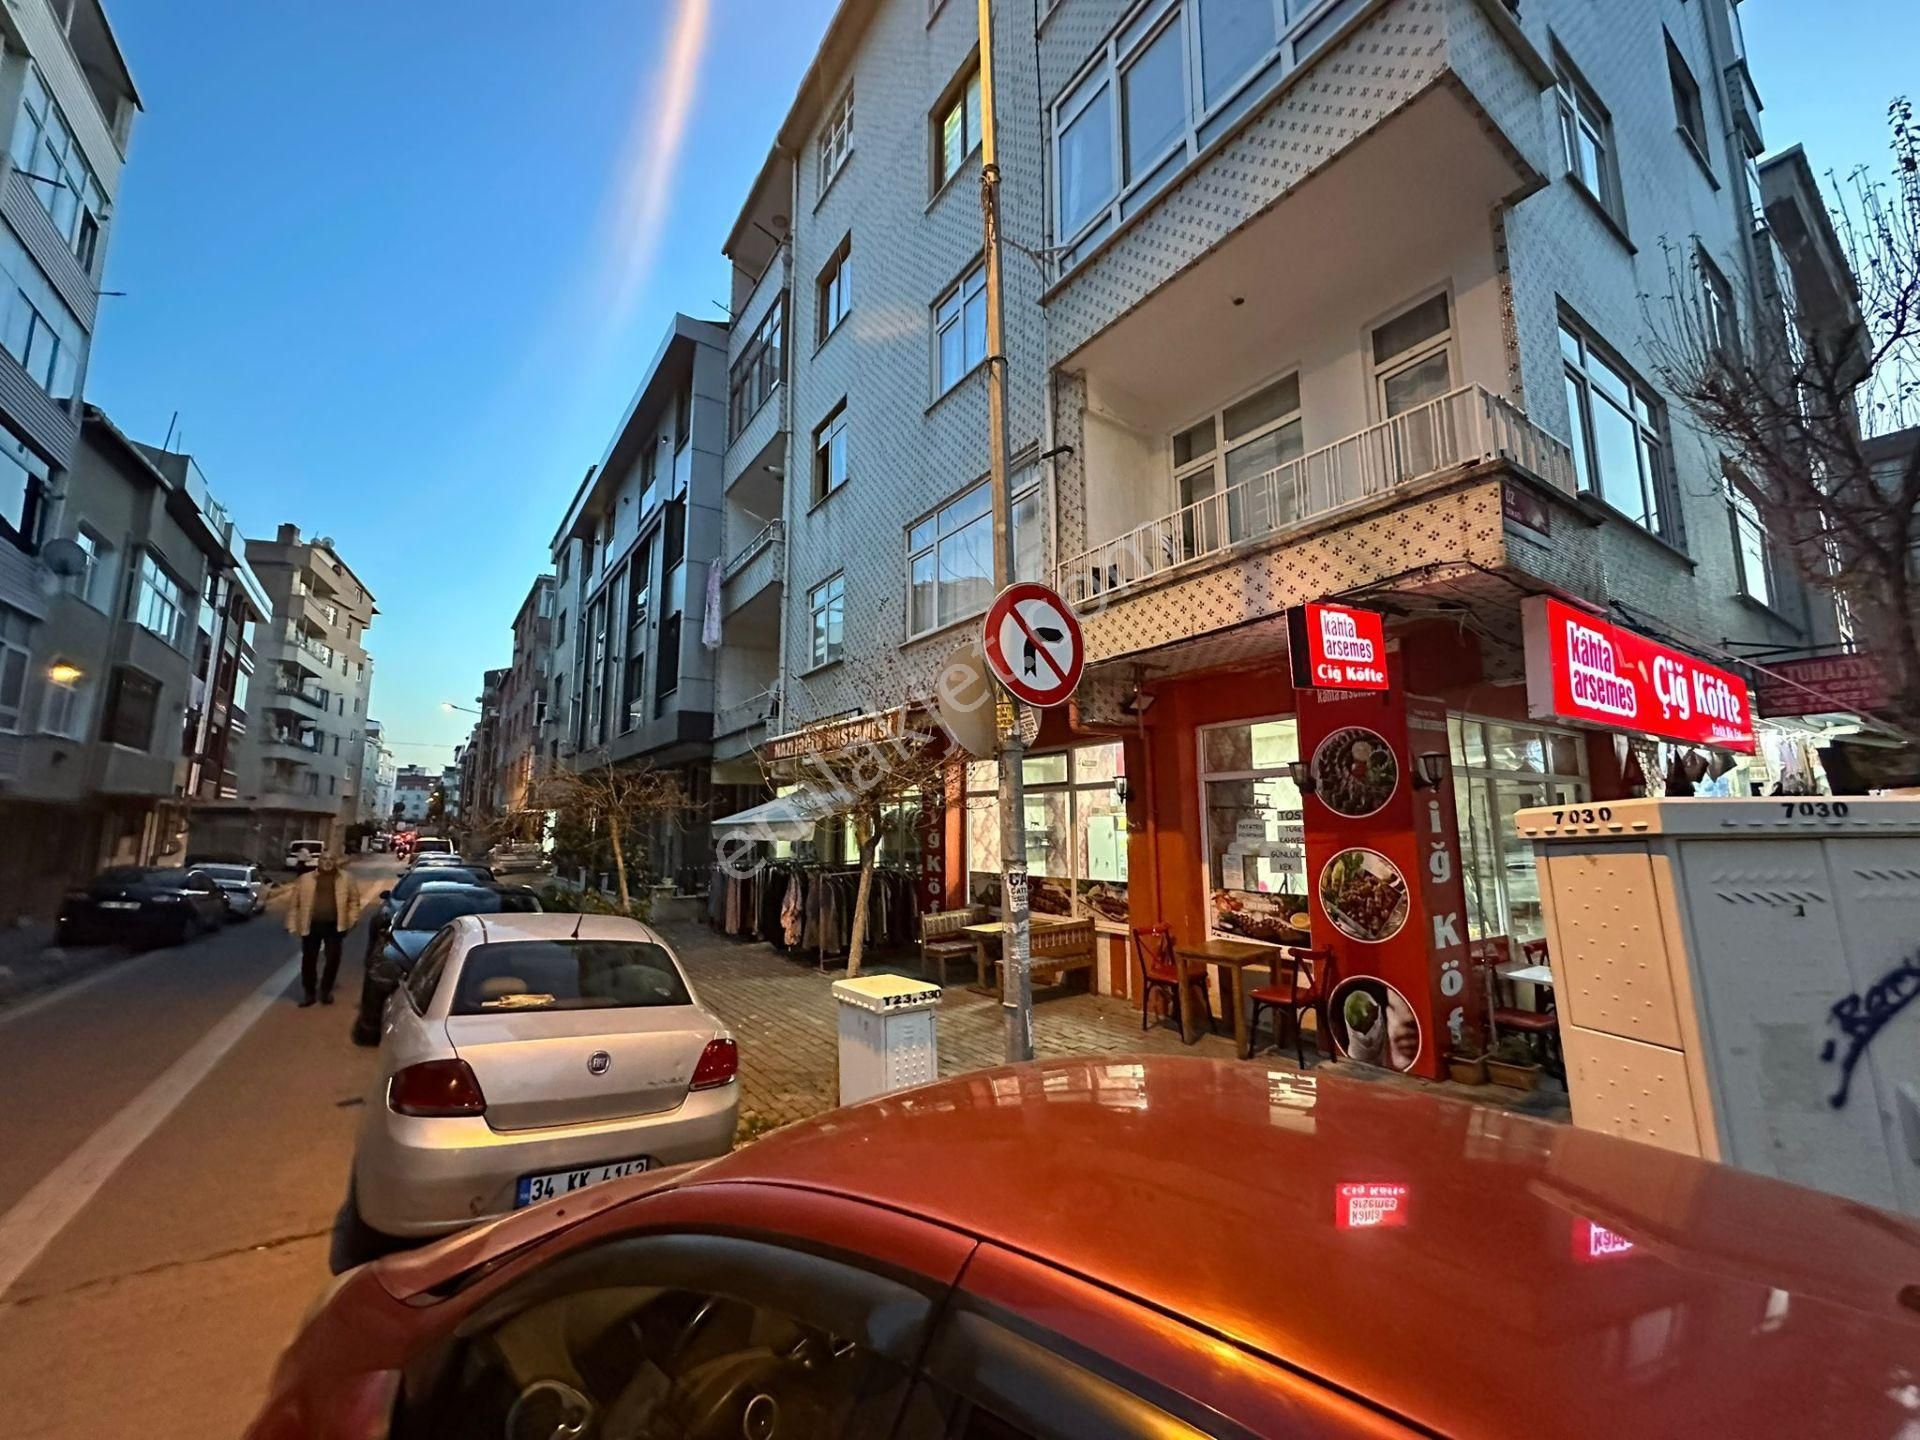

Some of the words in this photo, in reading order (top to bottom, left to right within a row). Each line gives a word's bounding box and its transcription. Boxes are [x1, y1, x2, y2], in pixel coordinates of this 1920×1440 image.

[1326, 638, 1372, 659] arsemes
[1570, 626, 1612, 674] kâhta
[1317, 663, 1342, 683] Çiğ
[1345, 665, 1384, 683] Köfte
[1573, 669, 1634, 712] arsemes
[1653, 655, 1690, 720] Çiğ
[1692, 668, 1742, 725] Köfte
[1552, 807, 1612, 825] 7030
[1782, 802, 1849, 818] 7030
[882, 989, 942, 1006] T23.330
[531, 1177, 555, 1201] 34
[567, 1170, 591, 1193] KK
